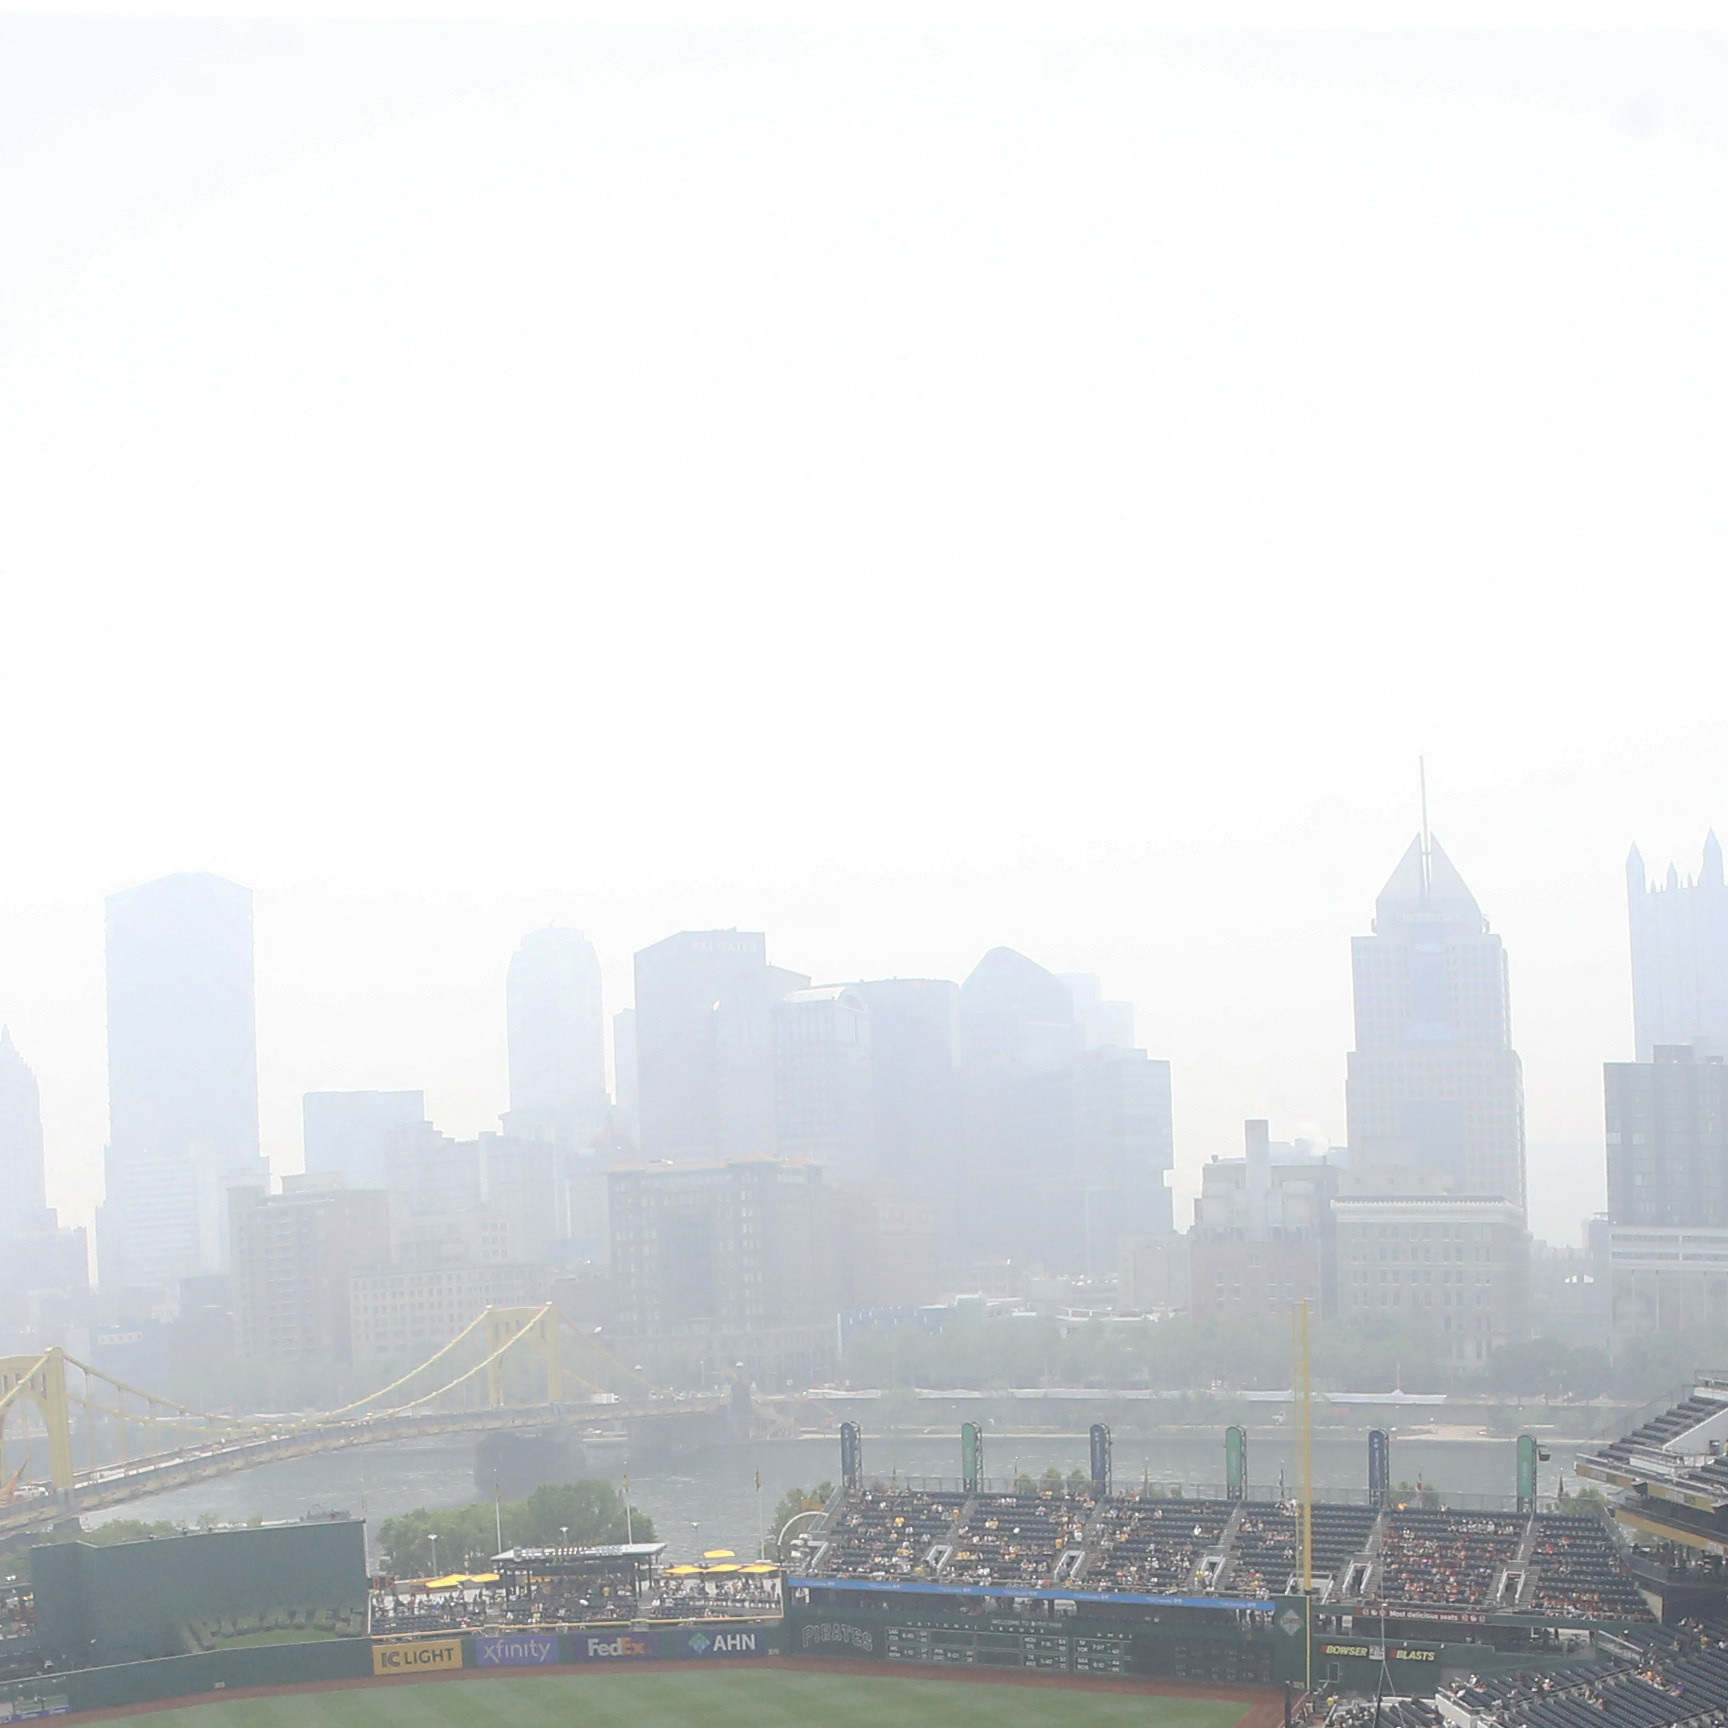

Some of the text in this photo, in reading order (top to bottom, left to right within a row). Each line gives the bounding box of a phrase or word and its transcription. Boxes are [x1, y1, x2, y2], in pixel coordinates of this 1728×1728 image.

[1389, 1610, 1406, 1618] Most
[587, 1636, 645, 1657] FedEx
[712, 1633, 756, 1652] AHN
[802, 1622, 872, 1652] PIRATES
[381, 1647, 454, 1668] IC LIGHT
[483, 1640, 551, 1665] xfinity
[1326, 1645, 1368, 1657] BOWSER
[1395, 1649, 1436, 1661] BLASTS
